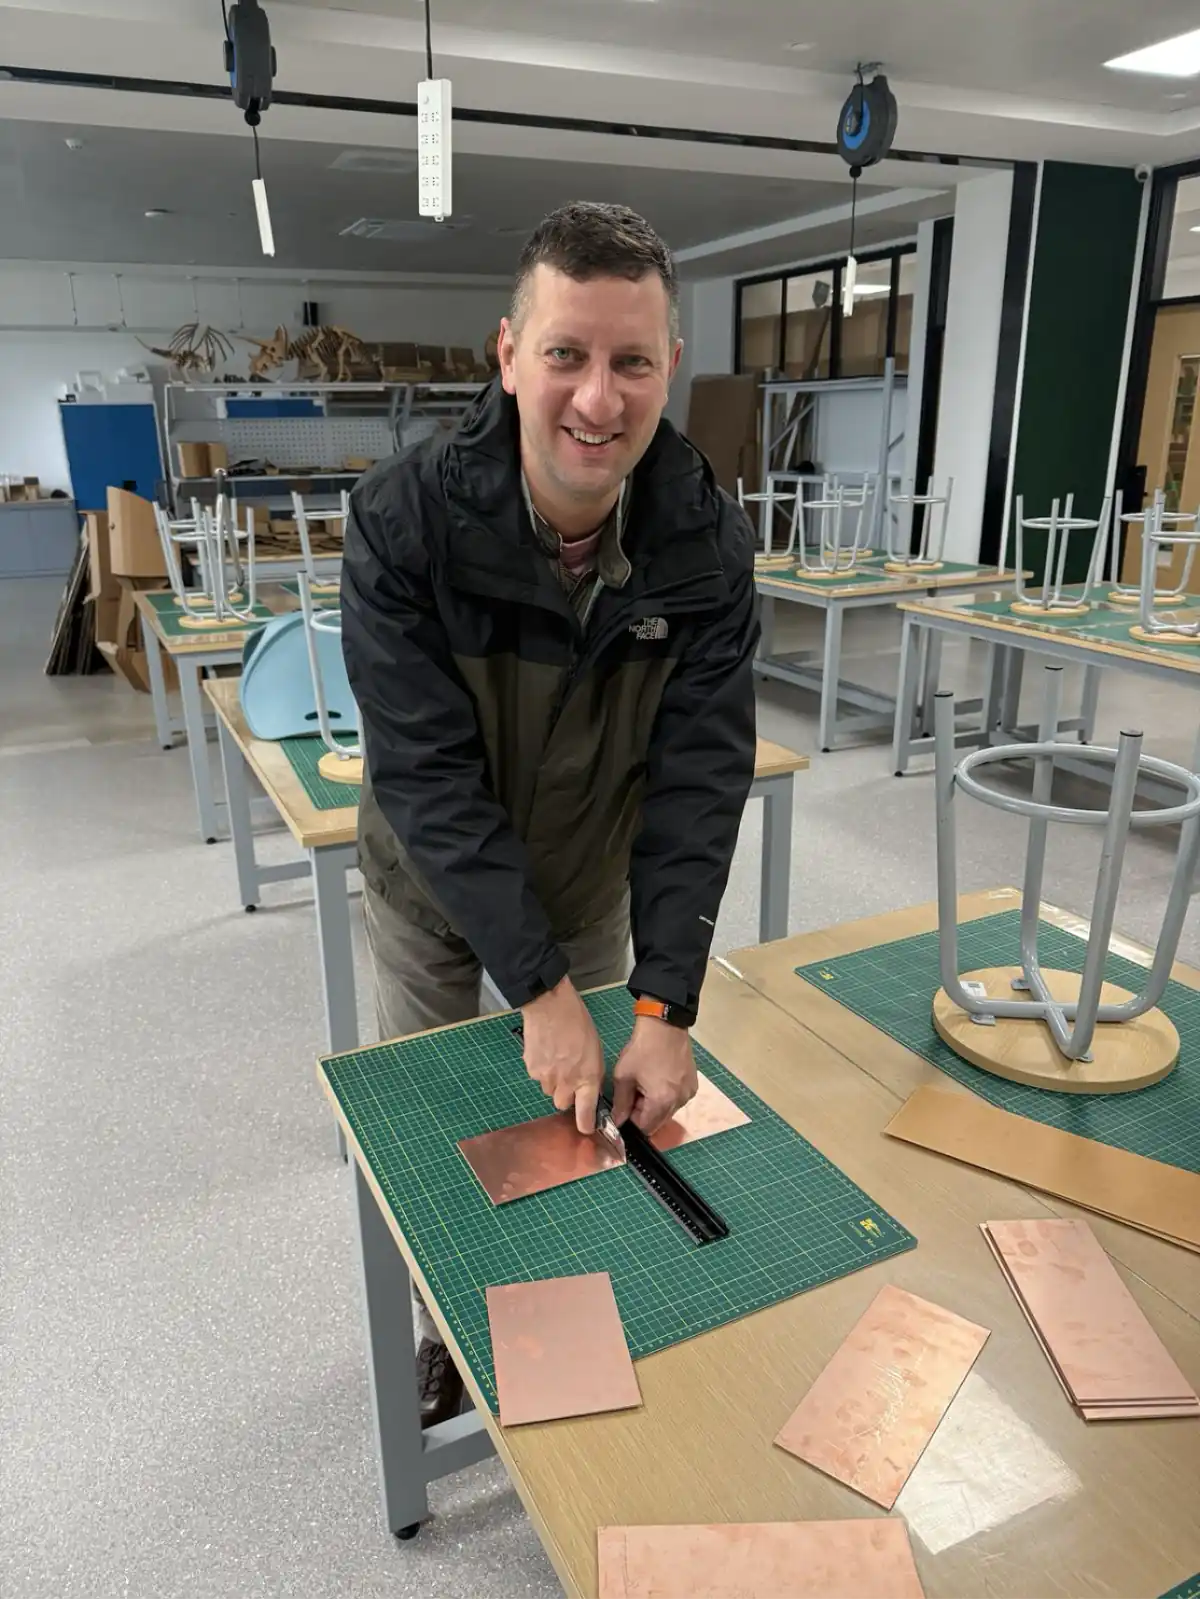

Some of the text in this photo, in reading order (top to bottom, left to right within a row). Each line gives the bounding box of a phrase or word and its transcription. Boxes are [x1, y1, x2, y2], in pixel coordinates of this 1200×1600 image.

[643, 617, 659, 626] THE
[628, 625, 658, 633] NORTH
[636, 632, 656, 640] FACE
